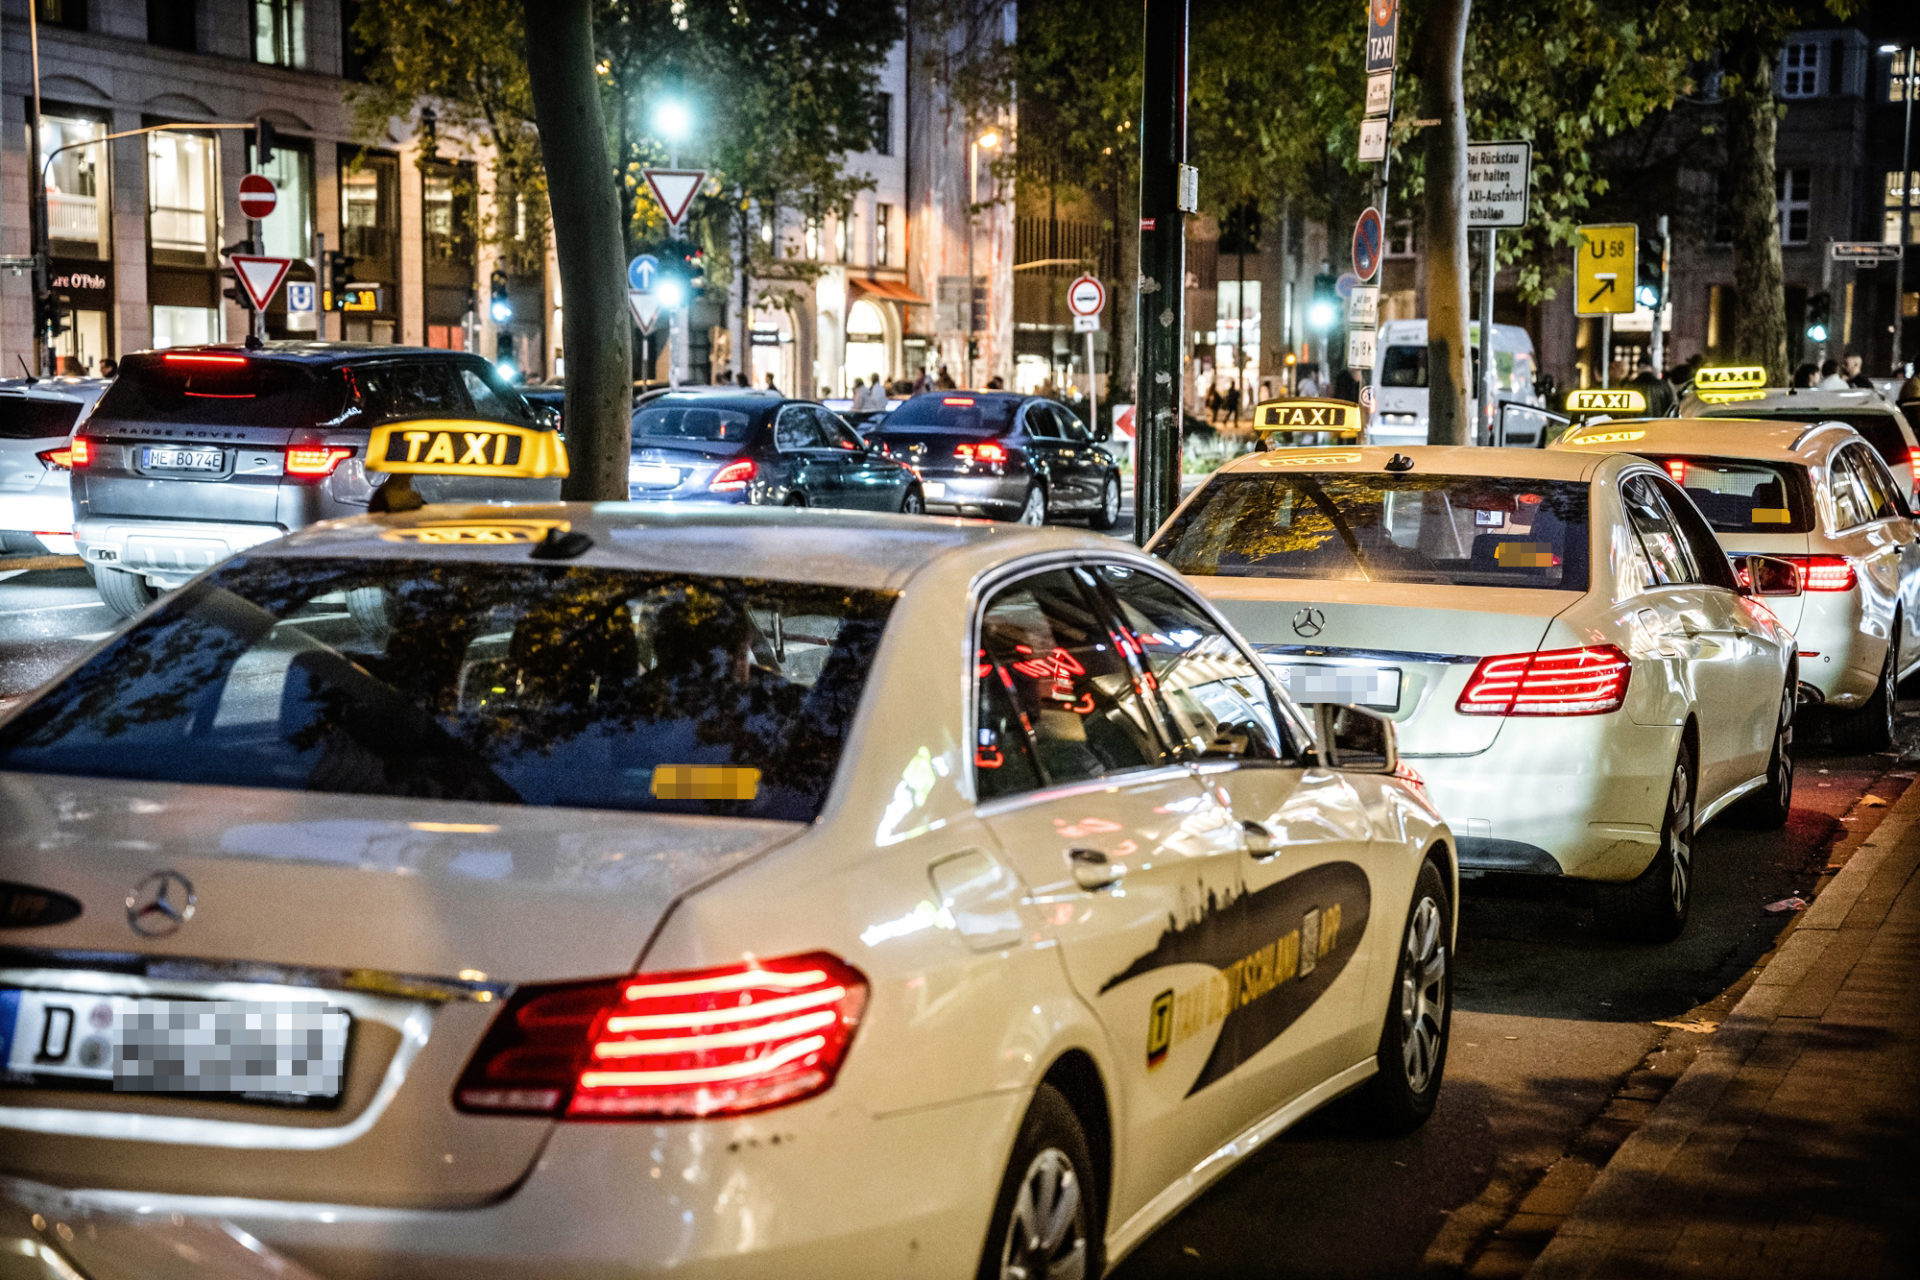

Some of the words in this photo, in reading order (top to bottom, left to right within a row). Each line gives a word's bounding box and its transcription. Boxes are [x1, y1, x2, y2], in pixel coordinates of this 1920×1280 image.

[1371, 35, 1393, 61] TAXI
[1481, 152, 1519, 164] Rückstau
[1484, 169, 1510, 182] halten
[1468, 189, 1523, 202] AXI-Ausfahrt
[1468, 206, 1504, 220] eihalten
[1591, 240, 1605, 259] U
[1610, 241, 1624, 258] 58
[292, 286, 311, 310] U
[1708, 371, 1755, 382] TAXI
[1579, 393, 1628, 408] TAXI
[1275, 408, 1336, 425] TAXI
[119, 428, 173, 436] RANGE
[185, 431, 246, 439] ROVER
[403, 431, 508, 465] TAXI
[151, 452, 168, 465] ME
